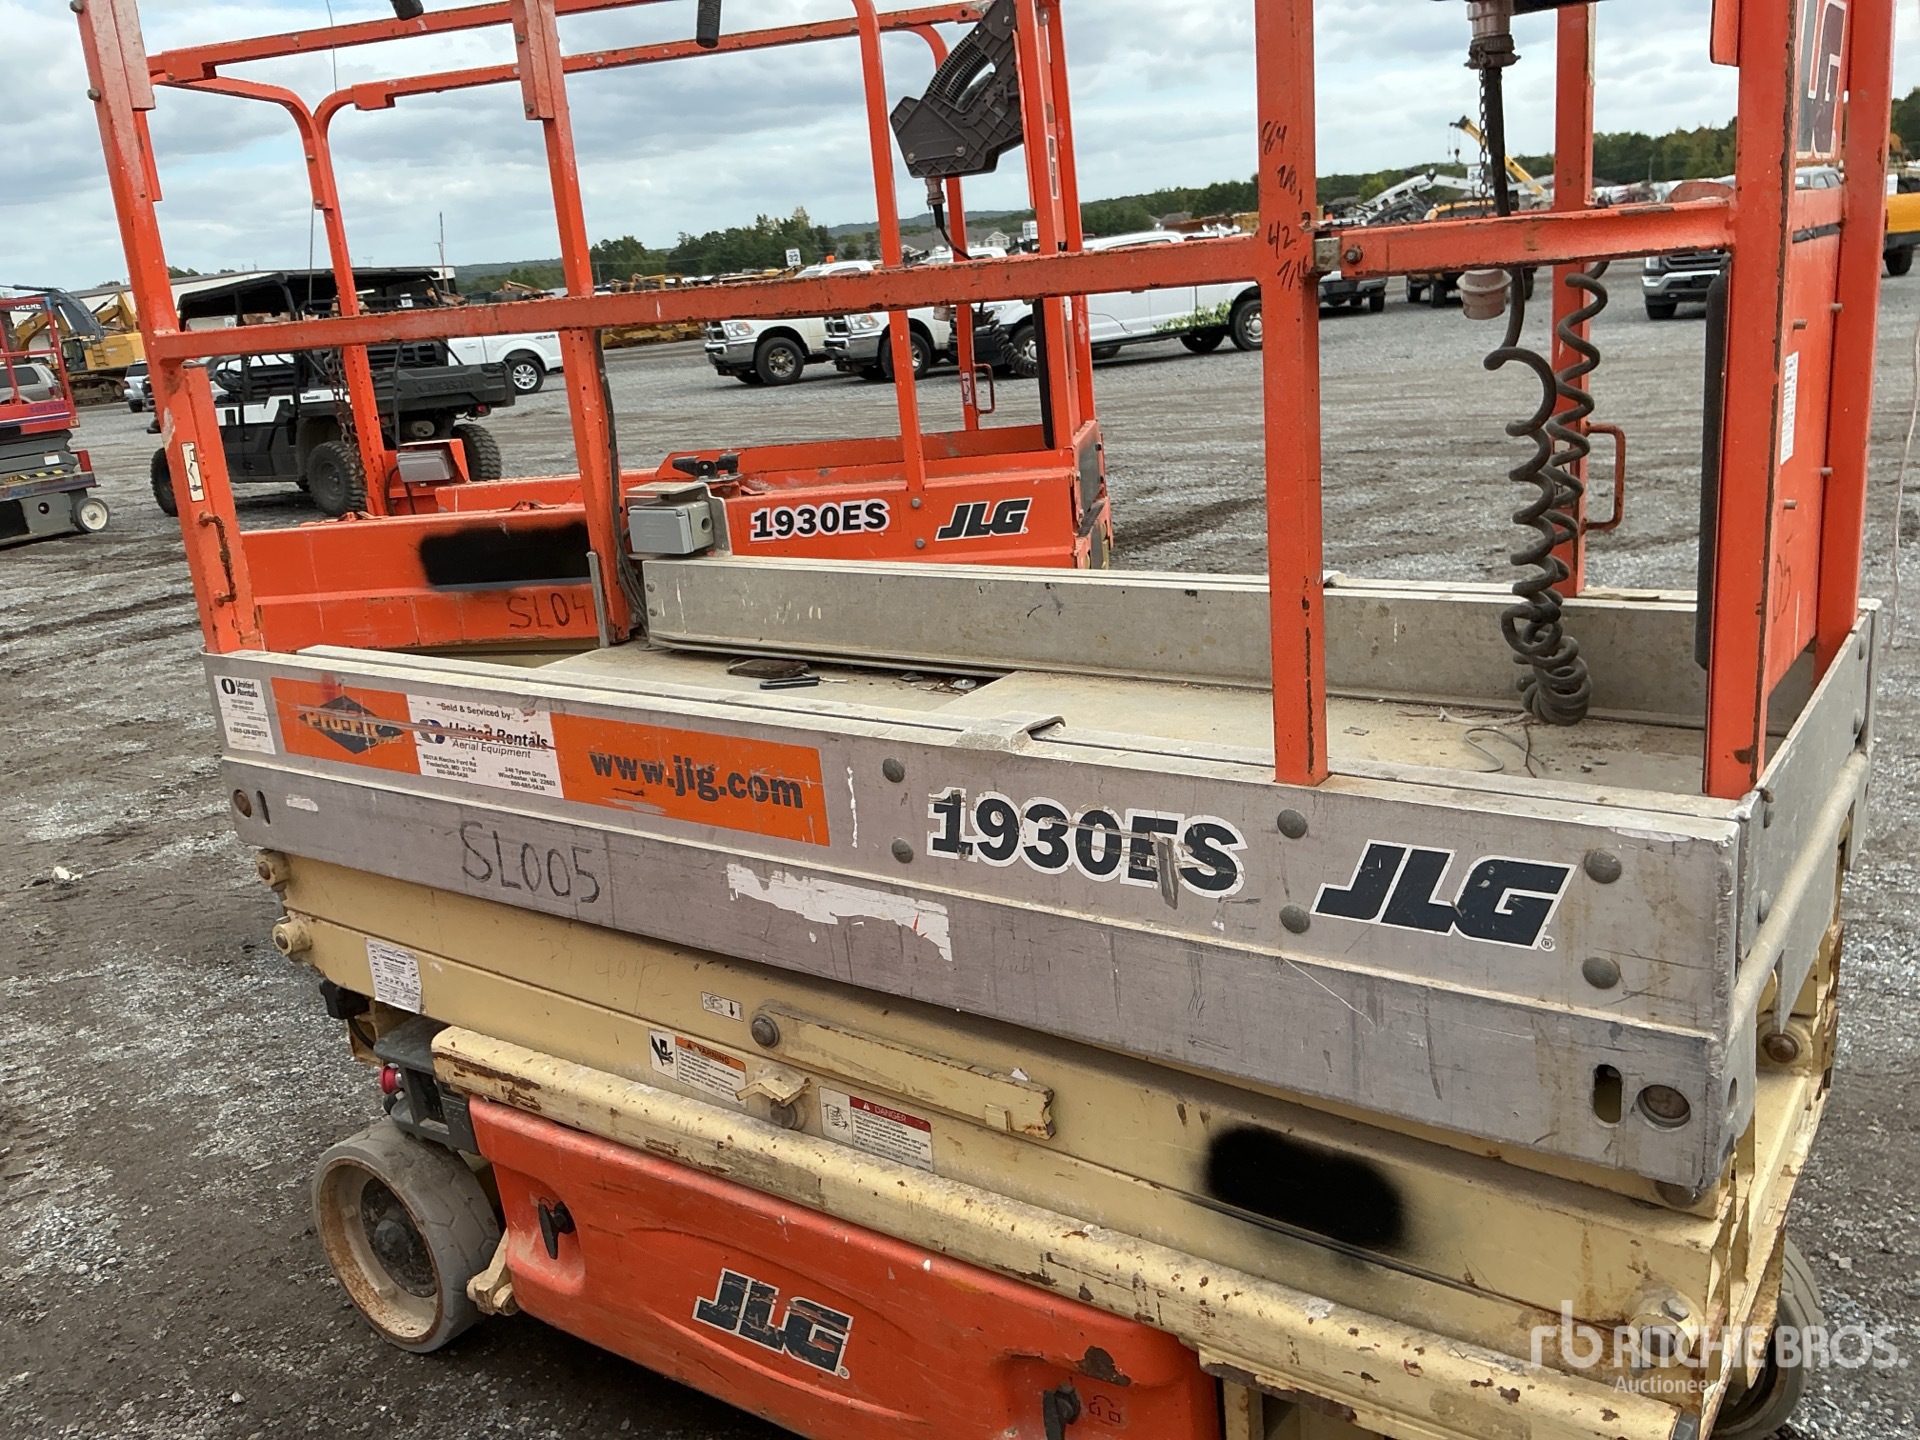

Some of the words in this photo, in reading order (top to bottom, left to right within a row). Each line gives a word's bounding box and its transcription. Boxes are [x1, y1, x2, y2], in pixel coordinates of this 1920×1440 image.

[1796, 0, 1848, 158] LG
[1267, 220, 1297, 260] 42
[752, 500, 889, 540] 1930ES
[936, 498, 1032, 541] JLG
[467, 705, 500, 718] Serviced
[452, 739, 479, 751] Aerial
[481, 742, 531, 759] Equipment
[497, 728, 549, 750] Rentals
[531, 770, 547, 779] Drive
[588, 751, 804, 809] www.jlg.com
[458, 820, 601, 904] SL005
[928, 788, 1245, 897] 1930ES
[1310, 839, 1577, 950] JLG
[874, 1105, 907, 1122] DANGER
[692, 1268, 853, 1376] JLG
